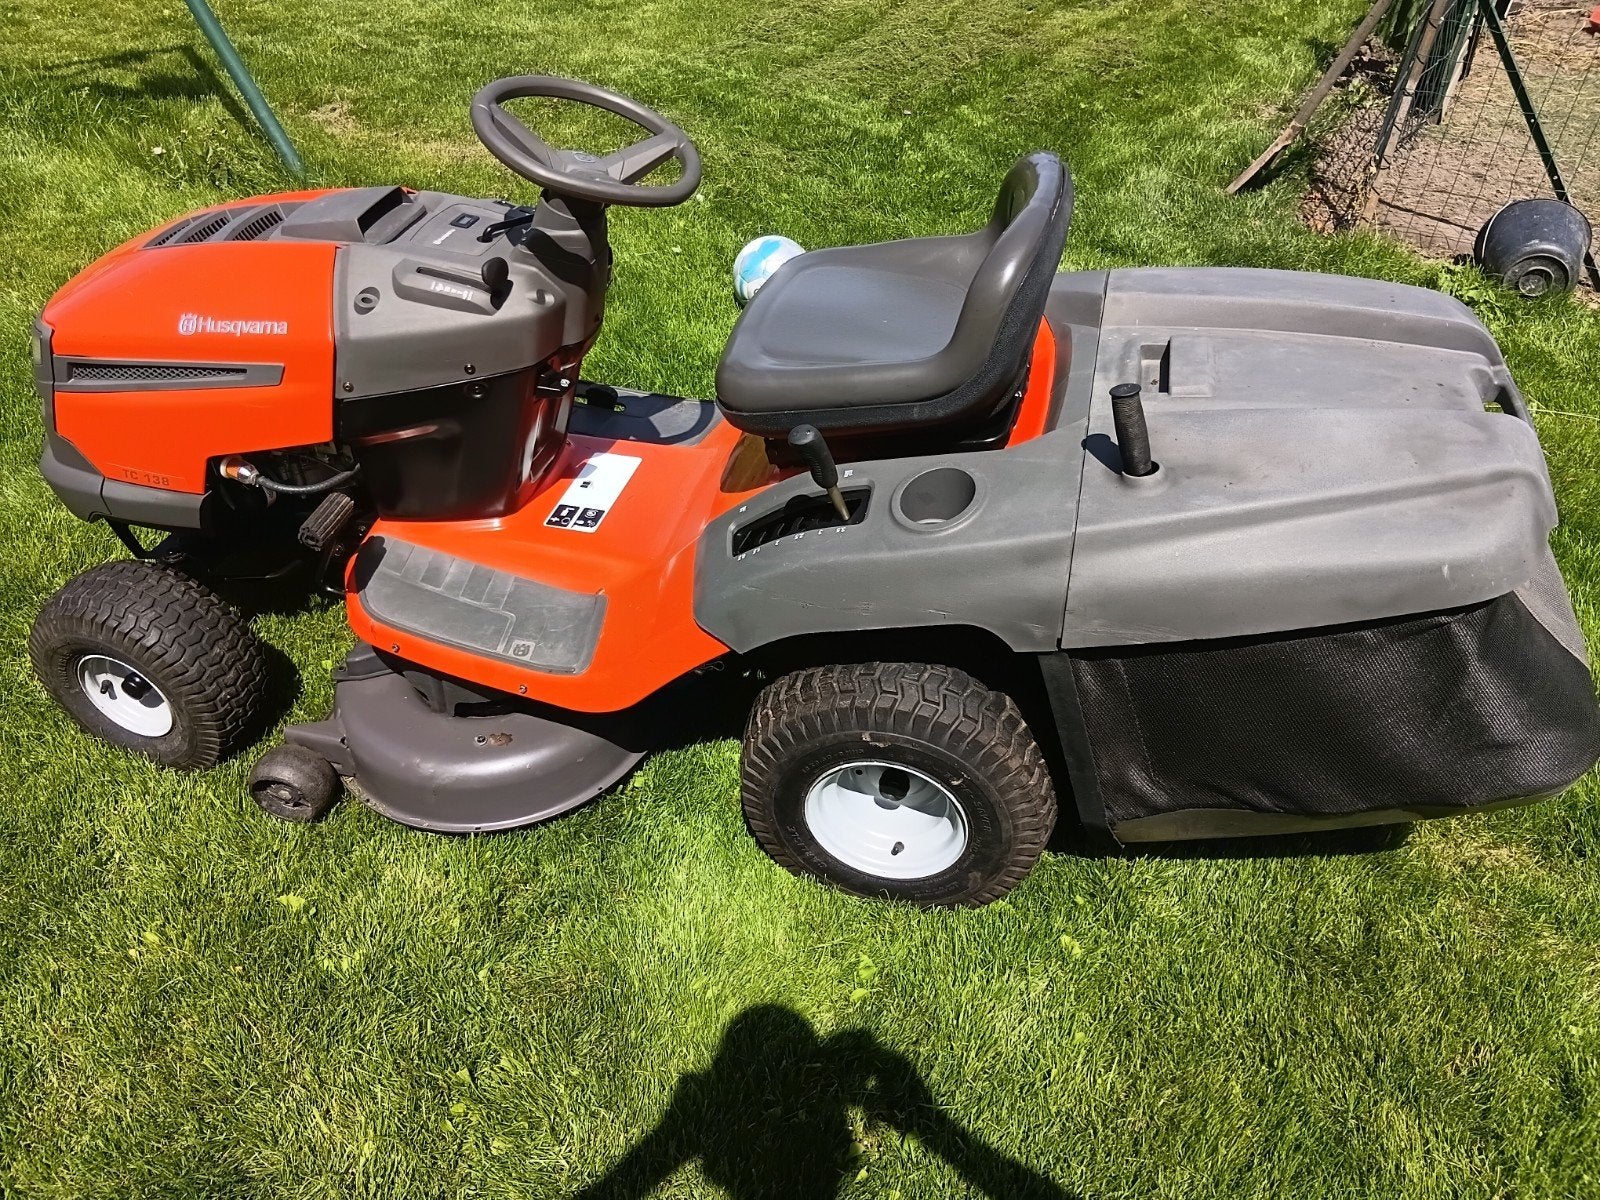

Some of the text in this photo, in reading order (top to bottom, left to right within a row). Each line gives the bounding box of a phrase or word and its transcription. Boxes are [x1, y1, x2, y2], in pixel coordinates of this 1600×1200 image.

[198, 316, 288, 336] Husqvarna
[122, 468, 170, 486] TC 138
